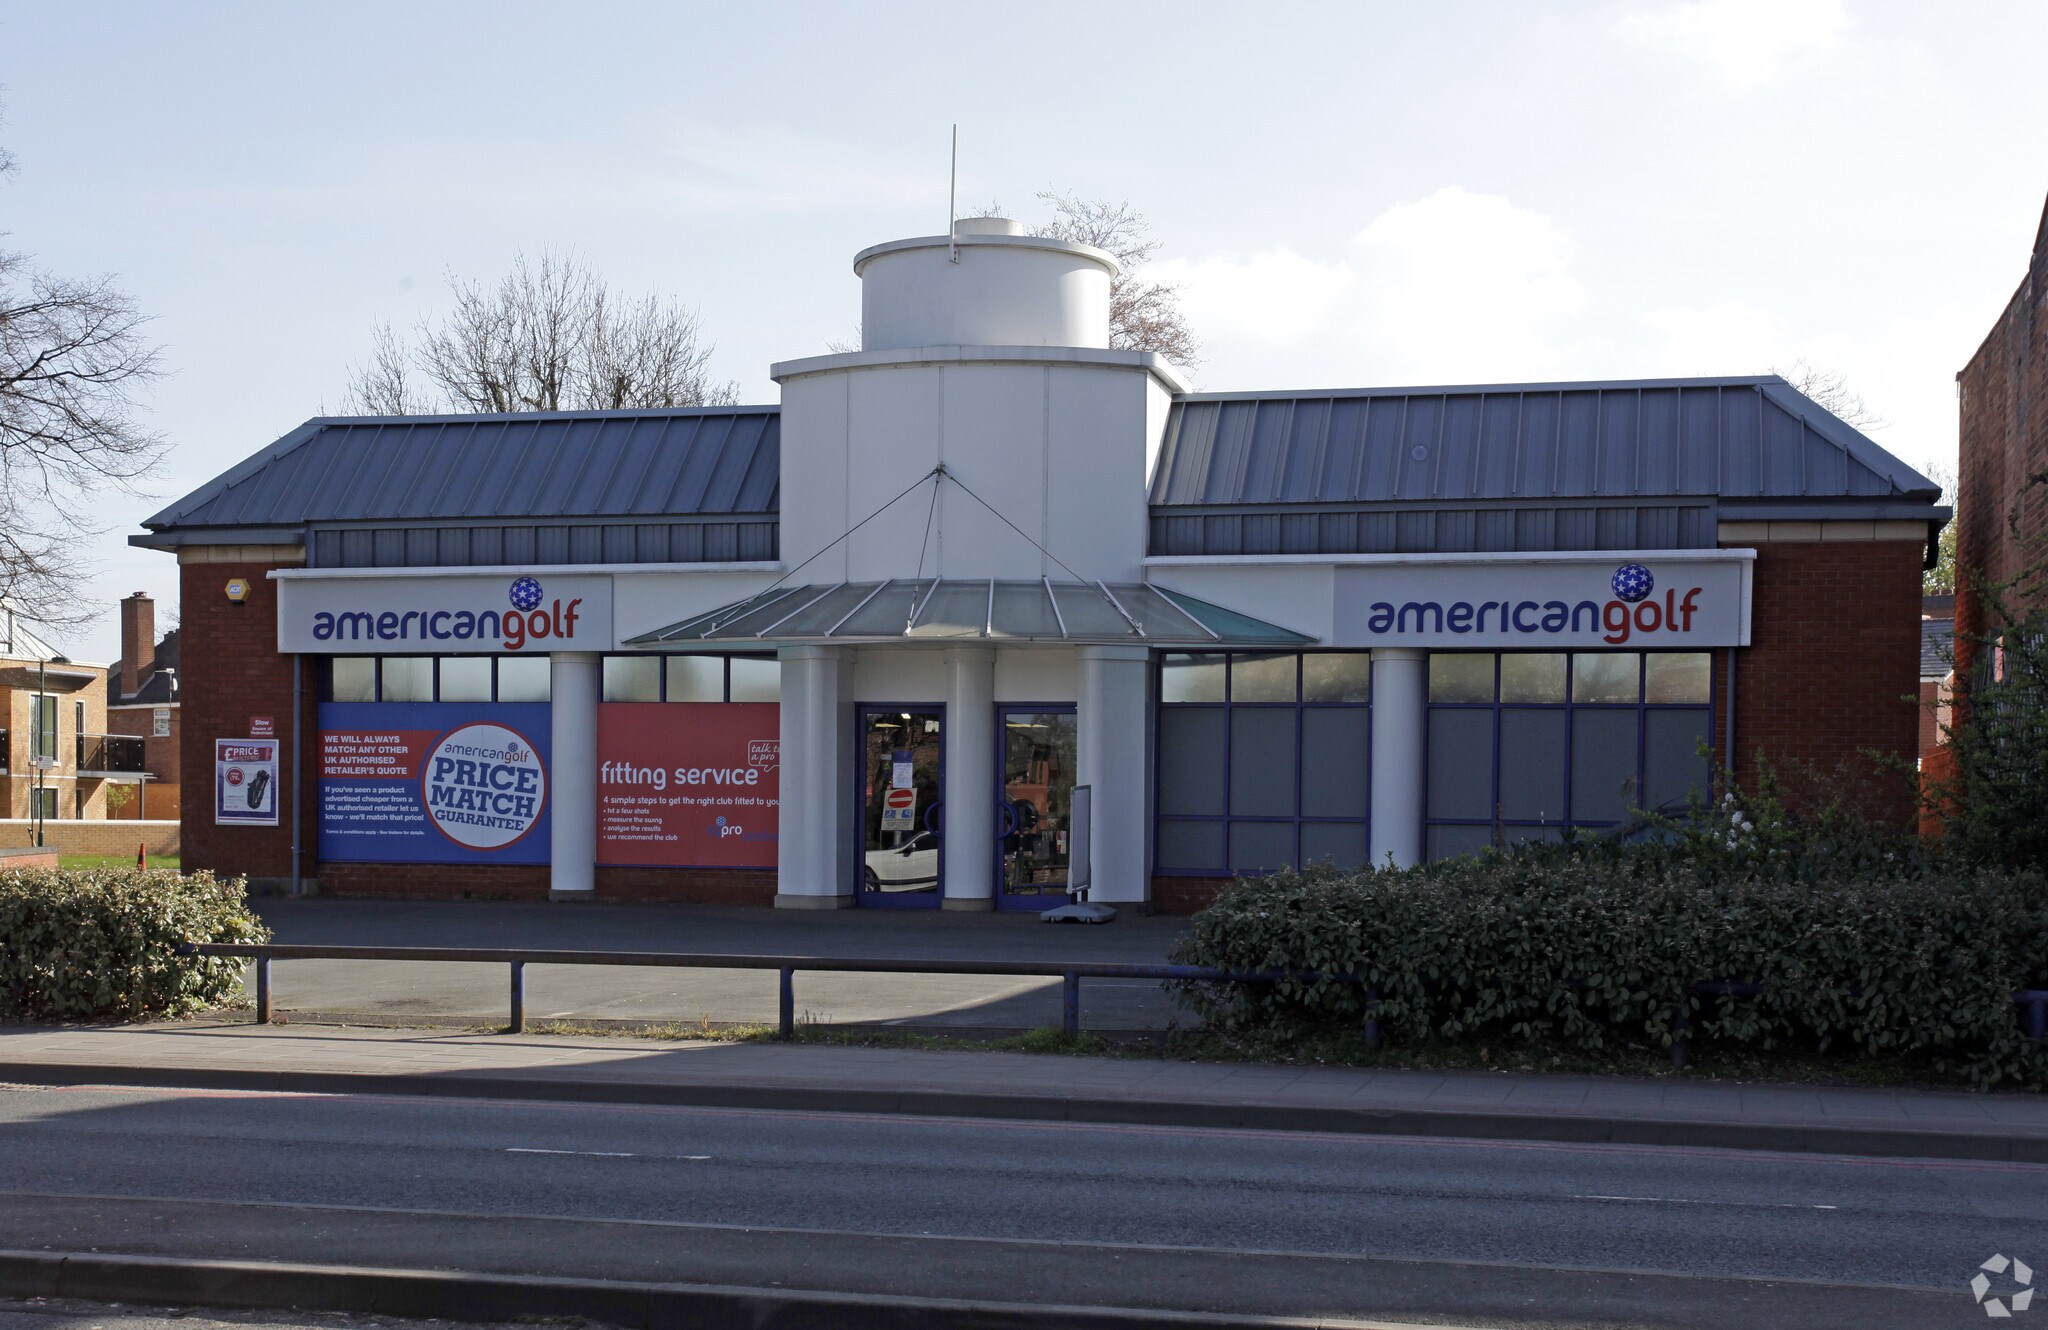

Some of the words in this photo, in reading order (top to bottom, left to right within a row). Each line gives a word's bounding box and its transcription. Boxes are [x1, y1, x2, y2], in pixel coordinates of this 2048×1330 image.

[1367, 587, 1702, 645] americangolf
[312, 598, 583, 651] americangolf
[324, 735, 339, 743] WE
[340, 735, 362, 743] WILL
[363, 735, 400, 744] ALWAYS
[324, 745, 356, 754] MATCH
[358, 745, 376, 754] ANY
[378, 745, 409, 754] OTHER
[751, 743, 772, 753] talk
[444, 743, 531, 764] americangolf
[324, 756, 338, 764] UK
[339, 756, 396, 764] AUTHORISED
[758, 753, 776, 765] pro
[324, 766, 375, 774] RETAILER'S
[376, 766, 408, 775] QUOTE
[432, 756, 539, 794] PRICE
[600, 760, 667, 790] fitting
[674, 767, 759, 785] service
[331, 786, 353, 794] you've
[378, 786, 405, 794] product
[361, 795, 389, 804] cheaper
[429, 784, 536, 818] MATCH
[603, 795, 609, 803] 4
[610, 796, 636, 805] simple
[637, 796, 658, 806] steps
[659, 796, 667, 804] to
[668, 796, 681, 806] get
[682, 796, 695, 805] the
[696, 796, 715, 806] right
[716, 796, 733, 805] club
[734, 796, 755, 805] fitted
[756, 797, 765, 805] to
[374, 804, 399, 812] retailer
[399, 804, 409, 812] let
[404, 814, 424, 822] price!
[434, 809, 525, 831] GUARANTEE
[607, 825, 630, 833] analyse
[721, 825, 743, 838] pro
